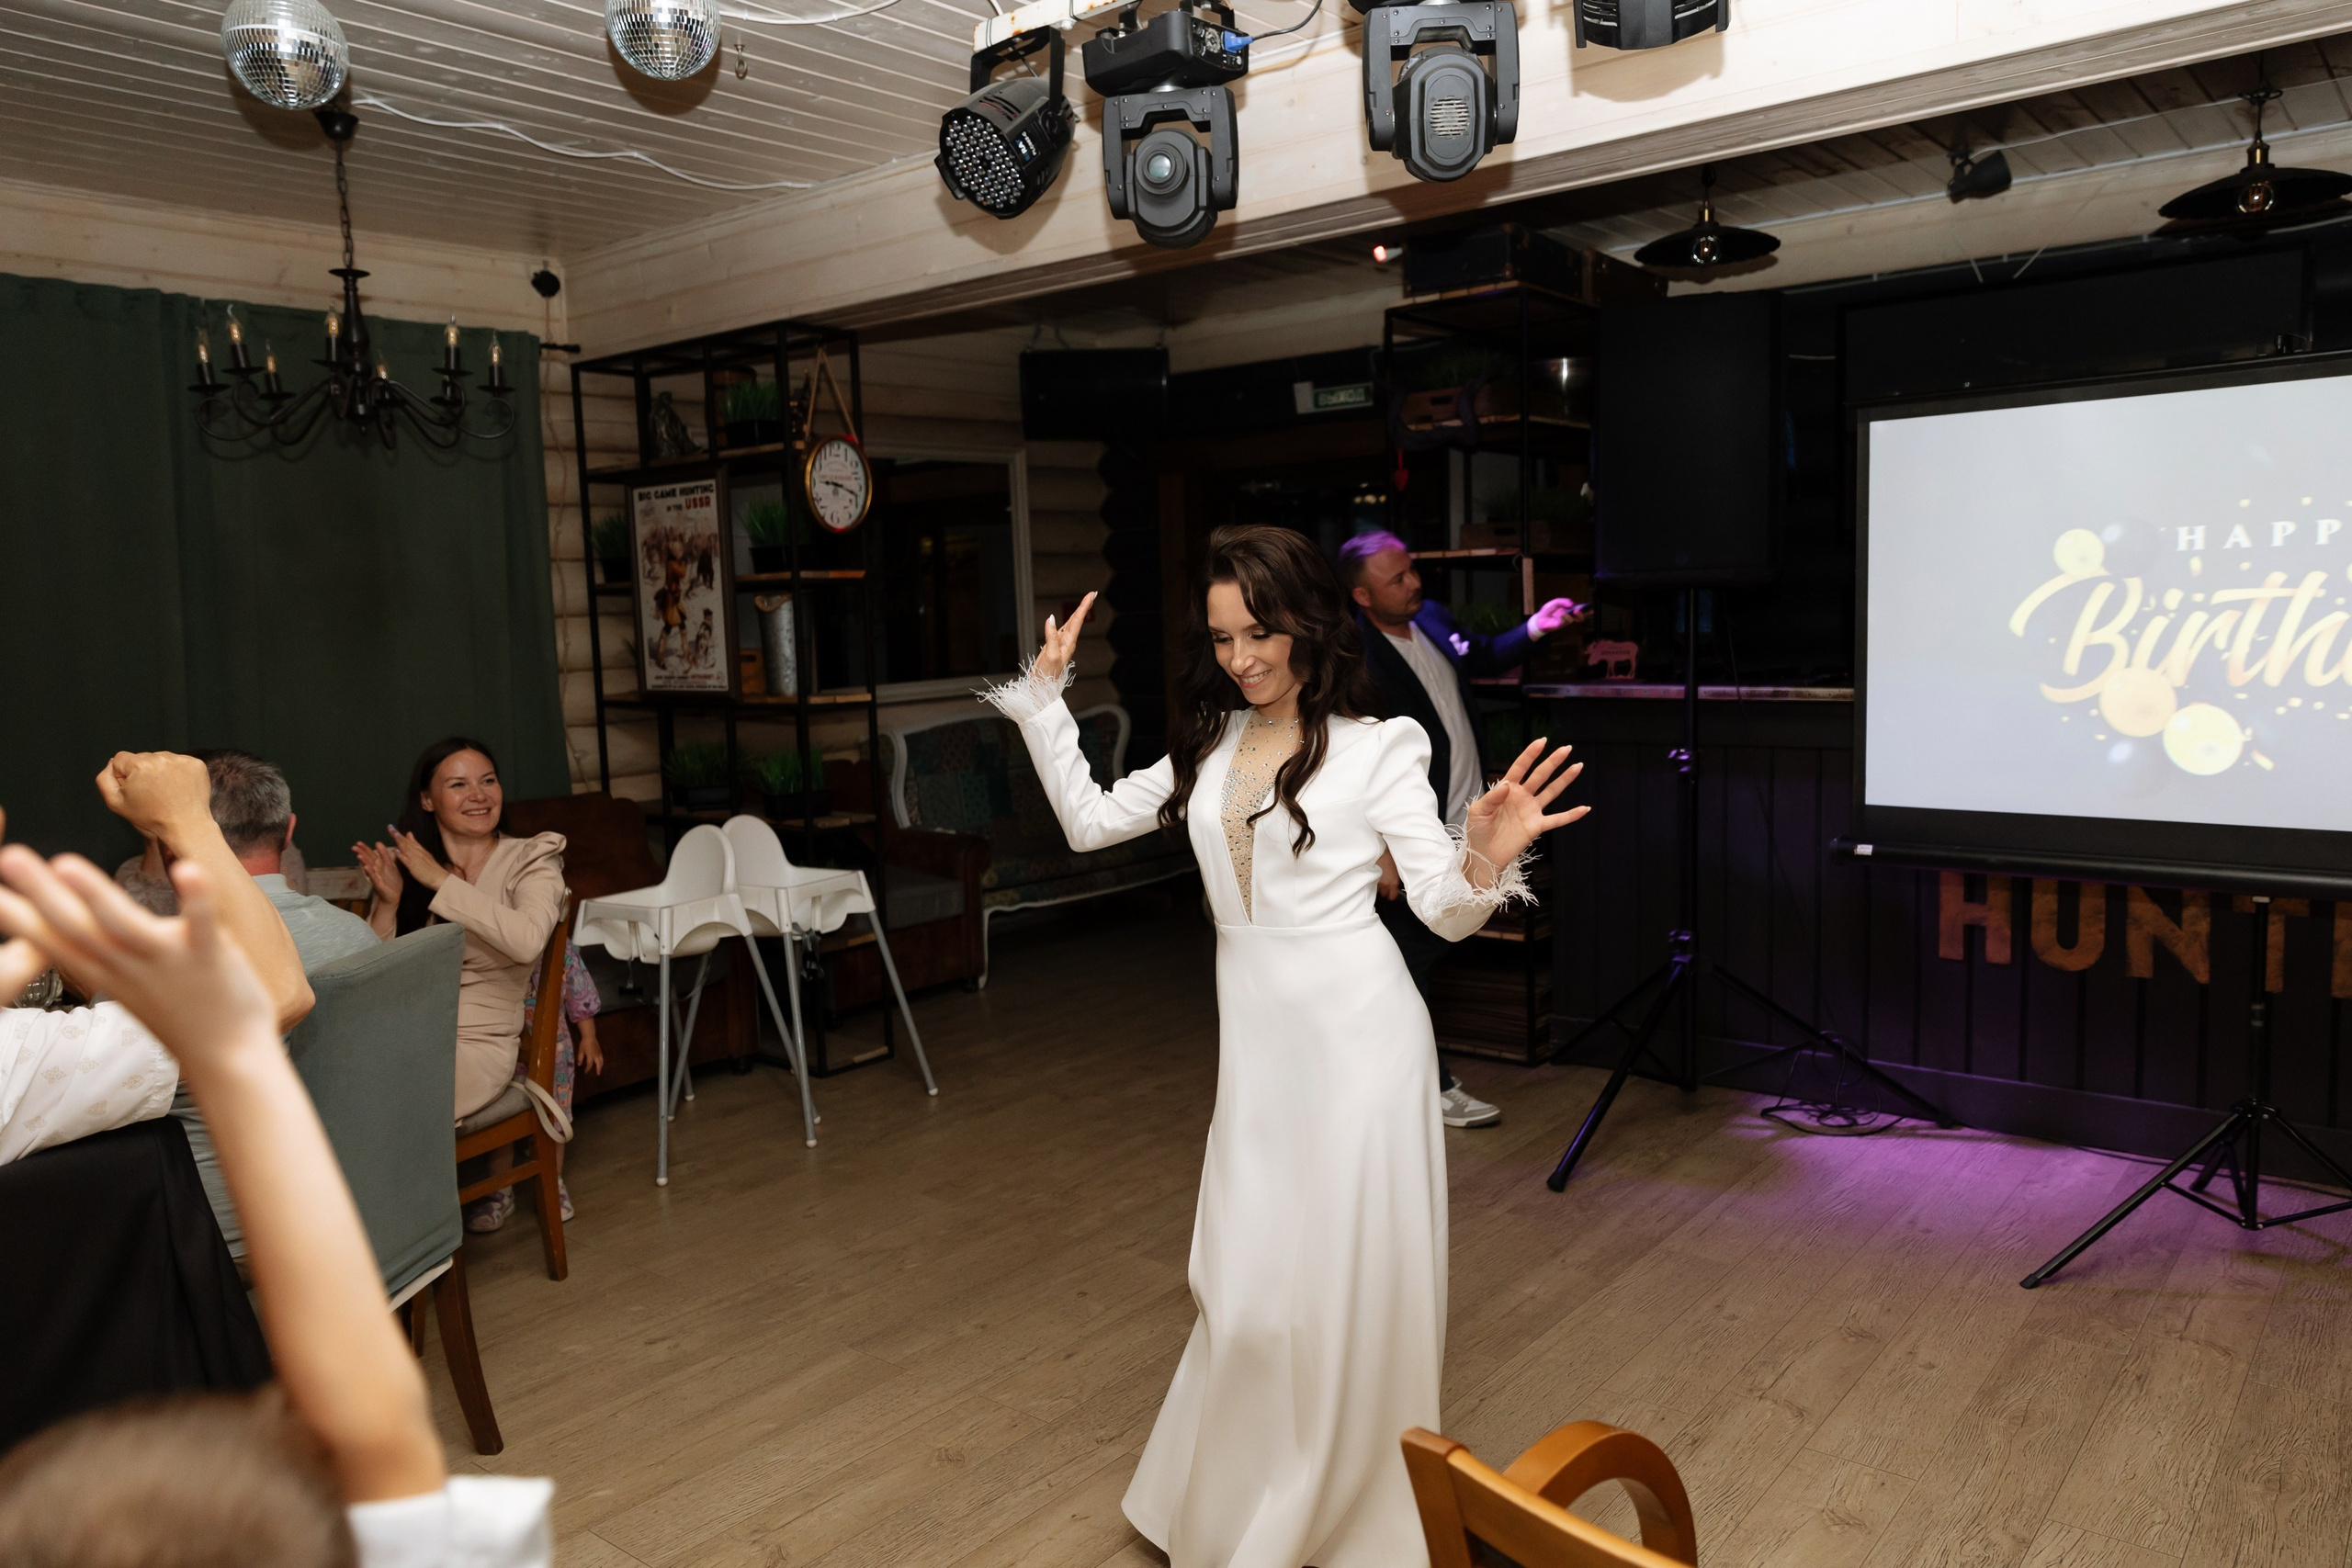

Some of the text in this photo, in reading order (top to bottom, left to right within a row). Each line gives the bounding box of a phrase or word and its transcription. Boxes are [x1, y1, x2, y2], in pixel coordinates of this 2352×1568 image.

[638, 484, 714, 502] BIG GAME HUNTING
[684, 496, 711, 510] USSR
[2177, 518, 2343, 551] HAPP
[2008, 570, 2352, 704] Birth
